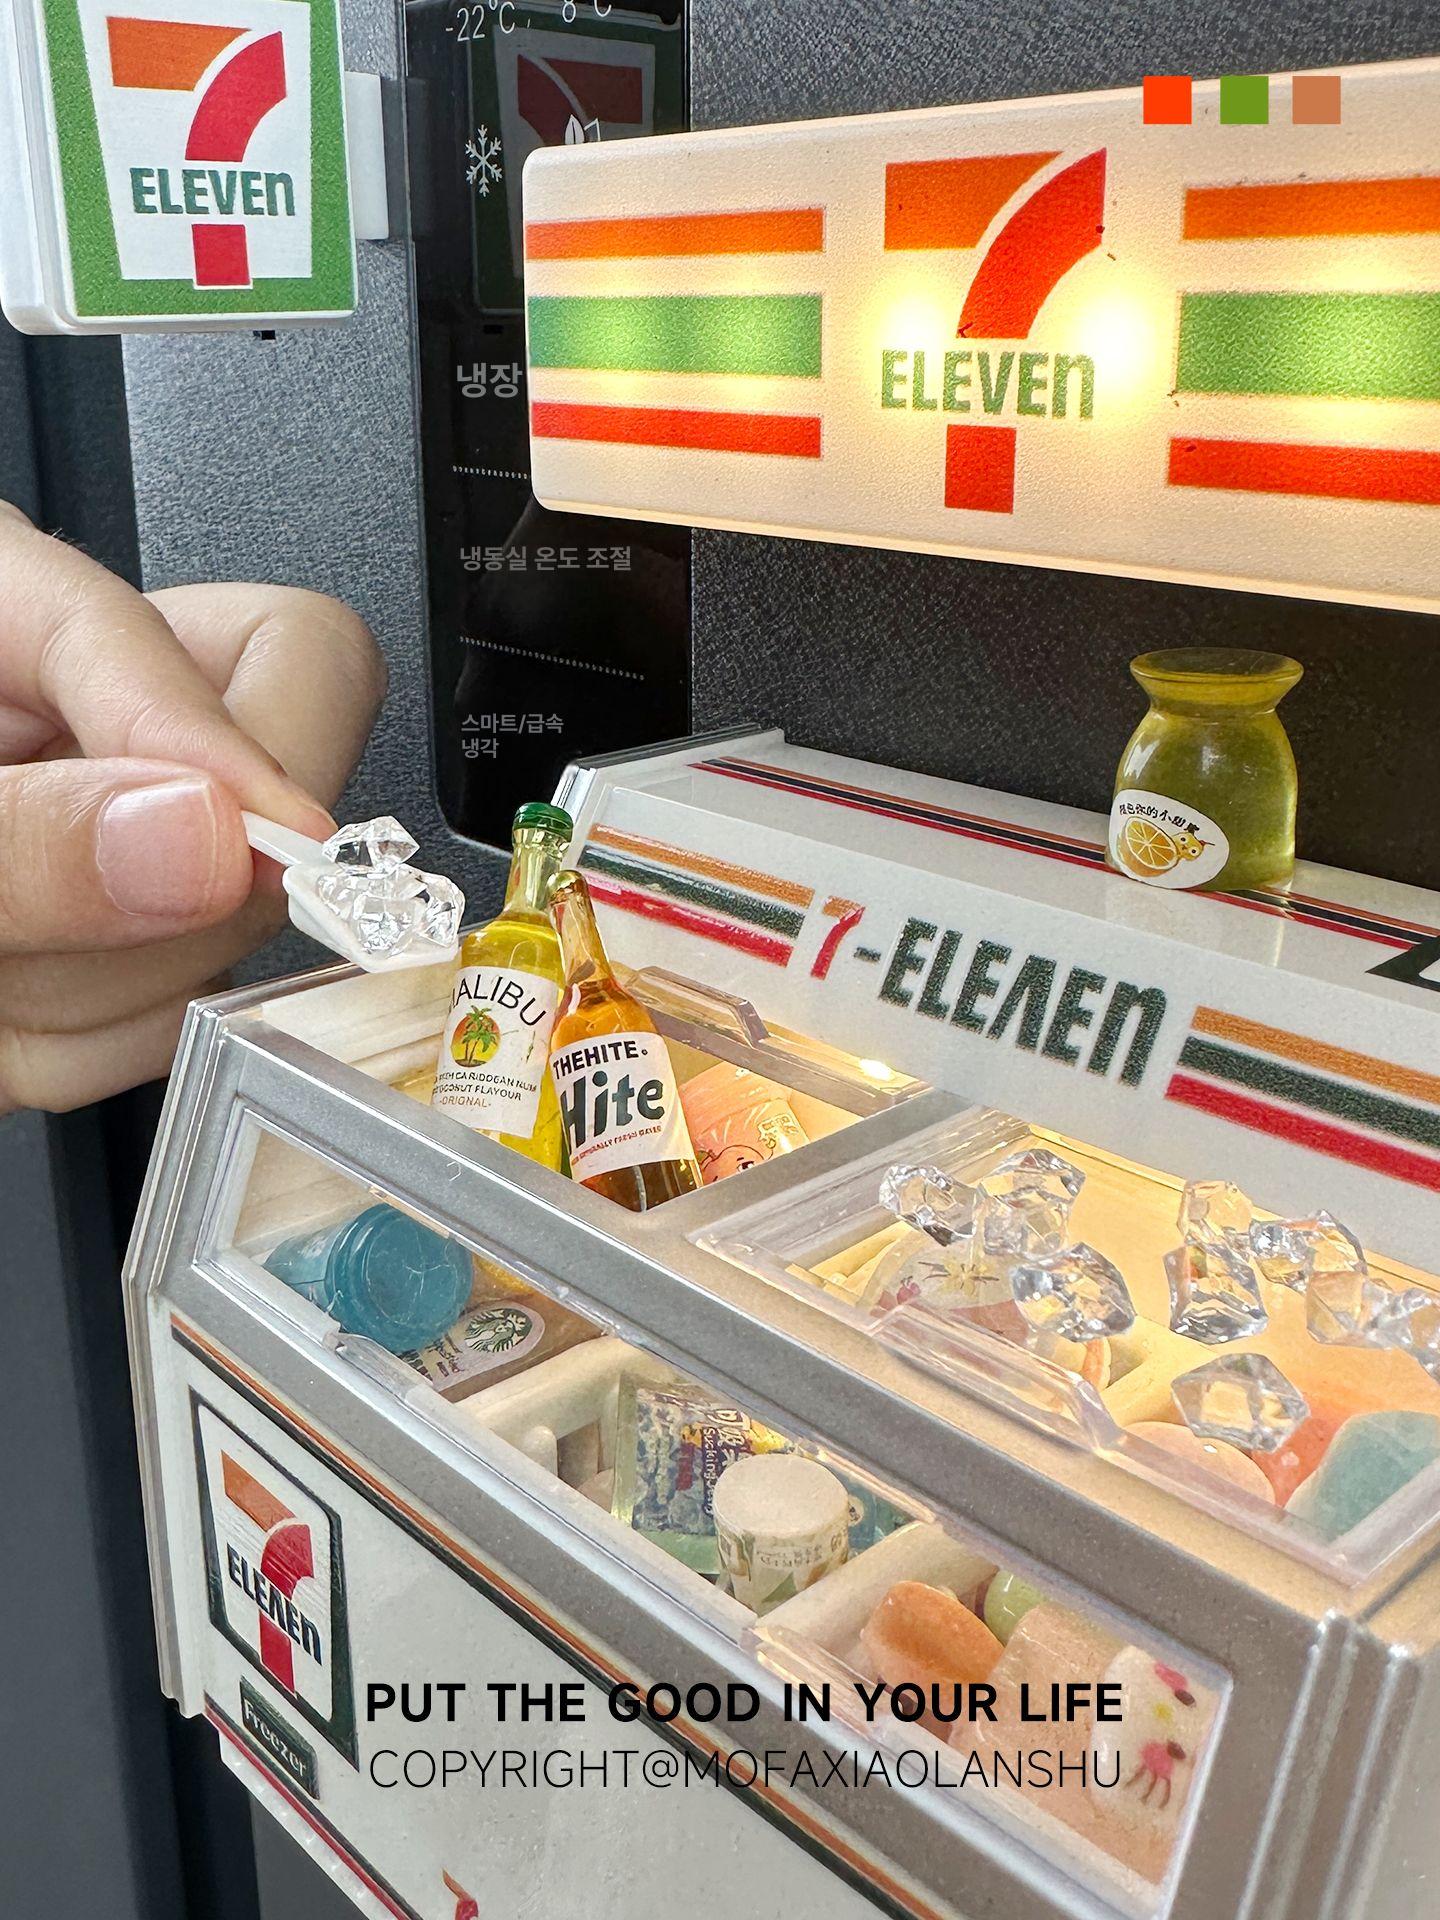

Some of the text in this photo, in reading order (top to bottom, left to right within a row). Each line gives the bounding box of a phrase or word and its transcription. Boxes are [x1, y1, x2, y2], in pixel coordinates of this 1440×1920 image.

[457, 362, 523, 399] 냉장
[460, 546, 632, 571] 냉동실 온도 조절
[461, 713, 564, 734] 스마트/급속
[461, 738, 500, 759] 냉각
[559, 1070, 665, 1156] Hite
[244, 1698, 307, 1778] Freezer
